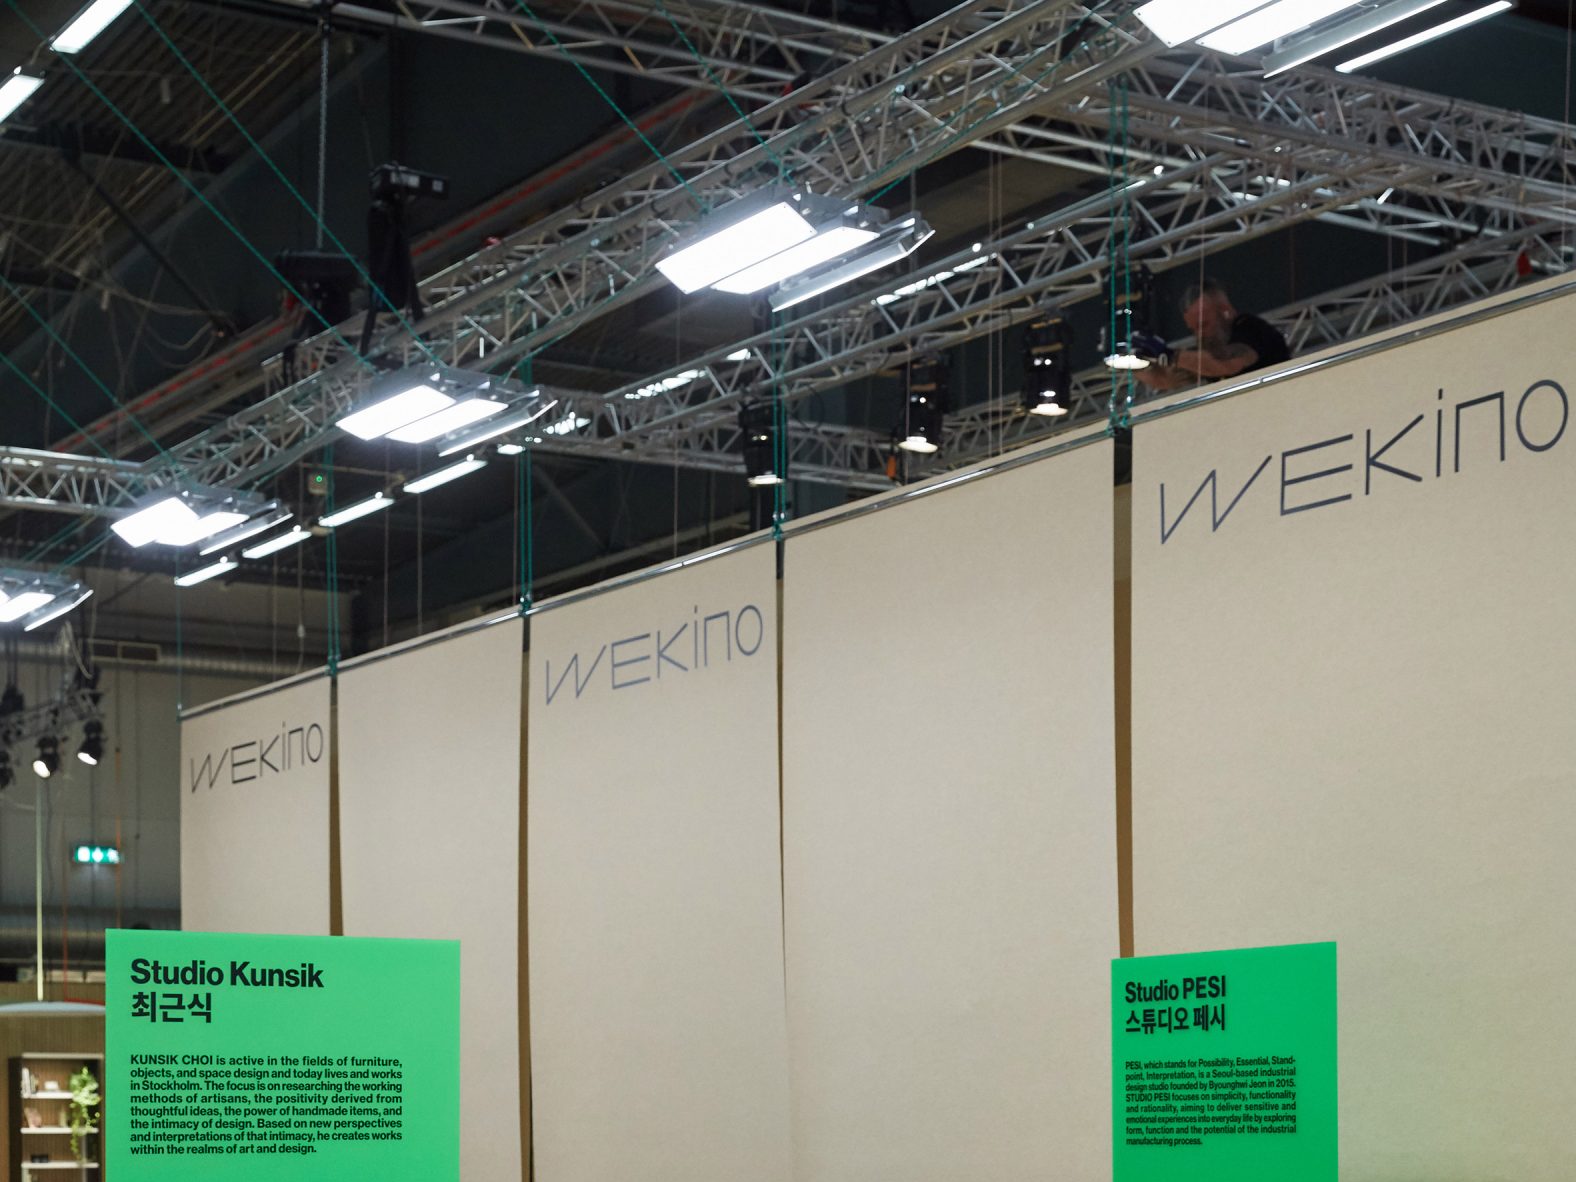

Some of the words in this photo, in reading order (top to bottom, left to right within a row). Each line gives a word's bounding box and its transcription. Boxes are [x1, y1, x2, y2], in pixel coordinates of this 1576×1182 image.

[130, 958, 224, 986] Studio
[230, 961, 325, 988] Kunsik
[1125, 979, 1179, 1004] Studio
[1183, 975, 1226, 999] PESI
[131, 991, 212, 1024] 최근식
[1125, 1006, 1190, 1035] 스튜디오
[1193, 1003, 1225, 1032] 페시
[130, 1054, 178, 1065] KUNSIK
[181, 1054, 212, 1065] CHOI
[216, 1055, 226, 1066] is
[228, 1055, 264, 1066] active
[267, 1055, 277, 1066] in
[280, 1055, 299, 1066] the
[302, 1055, 333, 1066] fields
[336, 1056, 348, 1066] of
[350, 1056, 402, 1069] furniture,
[1143, 1059, 1163, 1069] which
[1163, 1058, 1186, 1069] stands
[1187, 1058, 1197, 1068] for
[1198, 1057, 1235, 1069] Possibility,
[1271, 1055, 1296, 1066] Stand-
[130, 1067, 174, 1080] objects,
[176, 1068, 197, 1078] and
[198, 1070, 232, 1080] space
[233, 1068, 269, 1080] design
[270, 1068, 291, 1079] and
[292, 1068, 322, 1081] today
[324, 1068, 348, 1079] lives
[349, 1068, 369, 1079] and
[370, 1068, 402, 1079] works
[1146, 1069, 1196, 1082] Interpretation,
[1198, 1069, 1204, 1079] is
[1211, 1068, 1258, 1078] Seoul-based
[1259, 1066, 1296, 1077] industrial
[130, 1080, 140, 1091] in
[141, 1080, 202, 1091] Stockholm.
[203, 1080, 224, 1091] The
[226, 1080, 256, 1091] focus
[256, 1081, 266, 1091] is
[266, 1083, 280, 1091] on
[281, 1081, 342, 1094] researching
[344, 1081, 360, 1092] the
[361, 1081, 402, 1094] working
[1125, 1081, 1148, 1093] design
[1148, 1081, 1169, 1091] studio
[1169, 1080, 1198, 1090] founded
[1198, 1080, 1208, 1091] by
[1248, 1078, 1267, 1088] Jeon
[1267, 1078, 1274, 1088] in
[1275, 1078, 1296, 1088] 2015.
[130, 1093, 182, 1104] methods
[185, 1093, 198, 1104] of
[200, 1093, 251, 1106] artisans,
[253, 1093, 272, 1104] the
[275, 1093, 328, 1106] positivity
[330, 1093, 373, 1104] derived
[376, 1093, 402, 1104] from
[1125, 1092, 1152, 1102] STUDIO
[1153, 1092, 1170, 1102] PESI
[1171, 1091, 1200, 1101] focuses
[1210, 1091, 1248, 1103] simplicity,
[1248, 1090, 1296, 1102] functionality
[130, 1105, 188, 1118] thoughtful
[189, 1105, 222, 1118] ideas,
[223, 1105, 242, 1116] the
[243, 1107, 278, 1118] power
[278, 1105, 290, 1116] of
[291, 1105, 348, 1116] handmade
[349, 1105, 381, 1118] items,
[382, 1105, 402, 1116] and
[1125, 1103, 1139, 1113] and
[1140, 1102, 1178, 1114] rationality,
[1180, 1102, 1205, 1114] aiming
[1206, 1102, 1214, 1112] to
[1216, 1102, 1242, 1112] deliver
[1244, 1102, 1279, 1112] sensitive
[1280, 1101, 1296, 1111] and
[130, 1118, 149, 1129] the
[151, 1118, 199, 1131] intimacy
[200, 1118, 213, 1129] of
[214, 1118, 254, 1131] design.
[256, 1118, 291, 1129] Based
[293, 1120, 307, 1128] on
[309, 1120, 332, 1128] new
[333, 1118, 402, 1130] perspectives
[1157, 1113, 1197, 1125] experiences
[1197, 1113, 1210, 1123] into
[1210, 1113, 1242, 1124] everyday
[1242, 1112, 1253, 1122] life
[1252, 1112, 1262, 1124] by
[1263, 1112, 1296, 1124] exploring
[130, 1131, 151, 1141] and
[152, 1130, 232, 1143] interpretations
[233, 1130, 245, 1141] of
[246, 1130, 267, 1141] that
[268, 1130, 315, 1143] intimacy,
[316, 1130, 330, 1141] he
[331, 1130, 370, 1141] creates
[371, 1130, 402, 1141] works
[1125, 1125, 1144, 1136] form,
[1145, 1125, 1174, 1134] function
[1175, 1124, 1189, 1134] and
[1190, 1124, 1202, 1134] the
[1203, 1124, 1236, 1136] potential
[1236, 1124, 1245, 1134] of
[1246, 1124, 1259, 1134] the
[1260, 1124, 1296, 1134] industrial
[1126, 1135, 1173, 1147] manufacturing
[1173, 1137, 1202, 1147] process.
[130, 1144, 164, 1155] within
[166, 1144, 184, 1154] the
[186, 1144, 224, 1154] realms
[225, 1143, 237, 1154] of
[238, 1143, 254, 1154] art
[256, 1143, 276, 1154] and
[278, 1143, 316, 1156] design.
